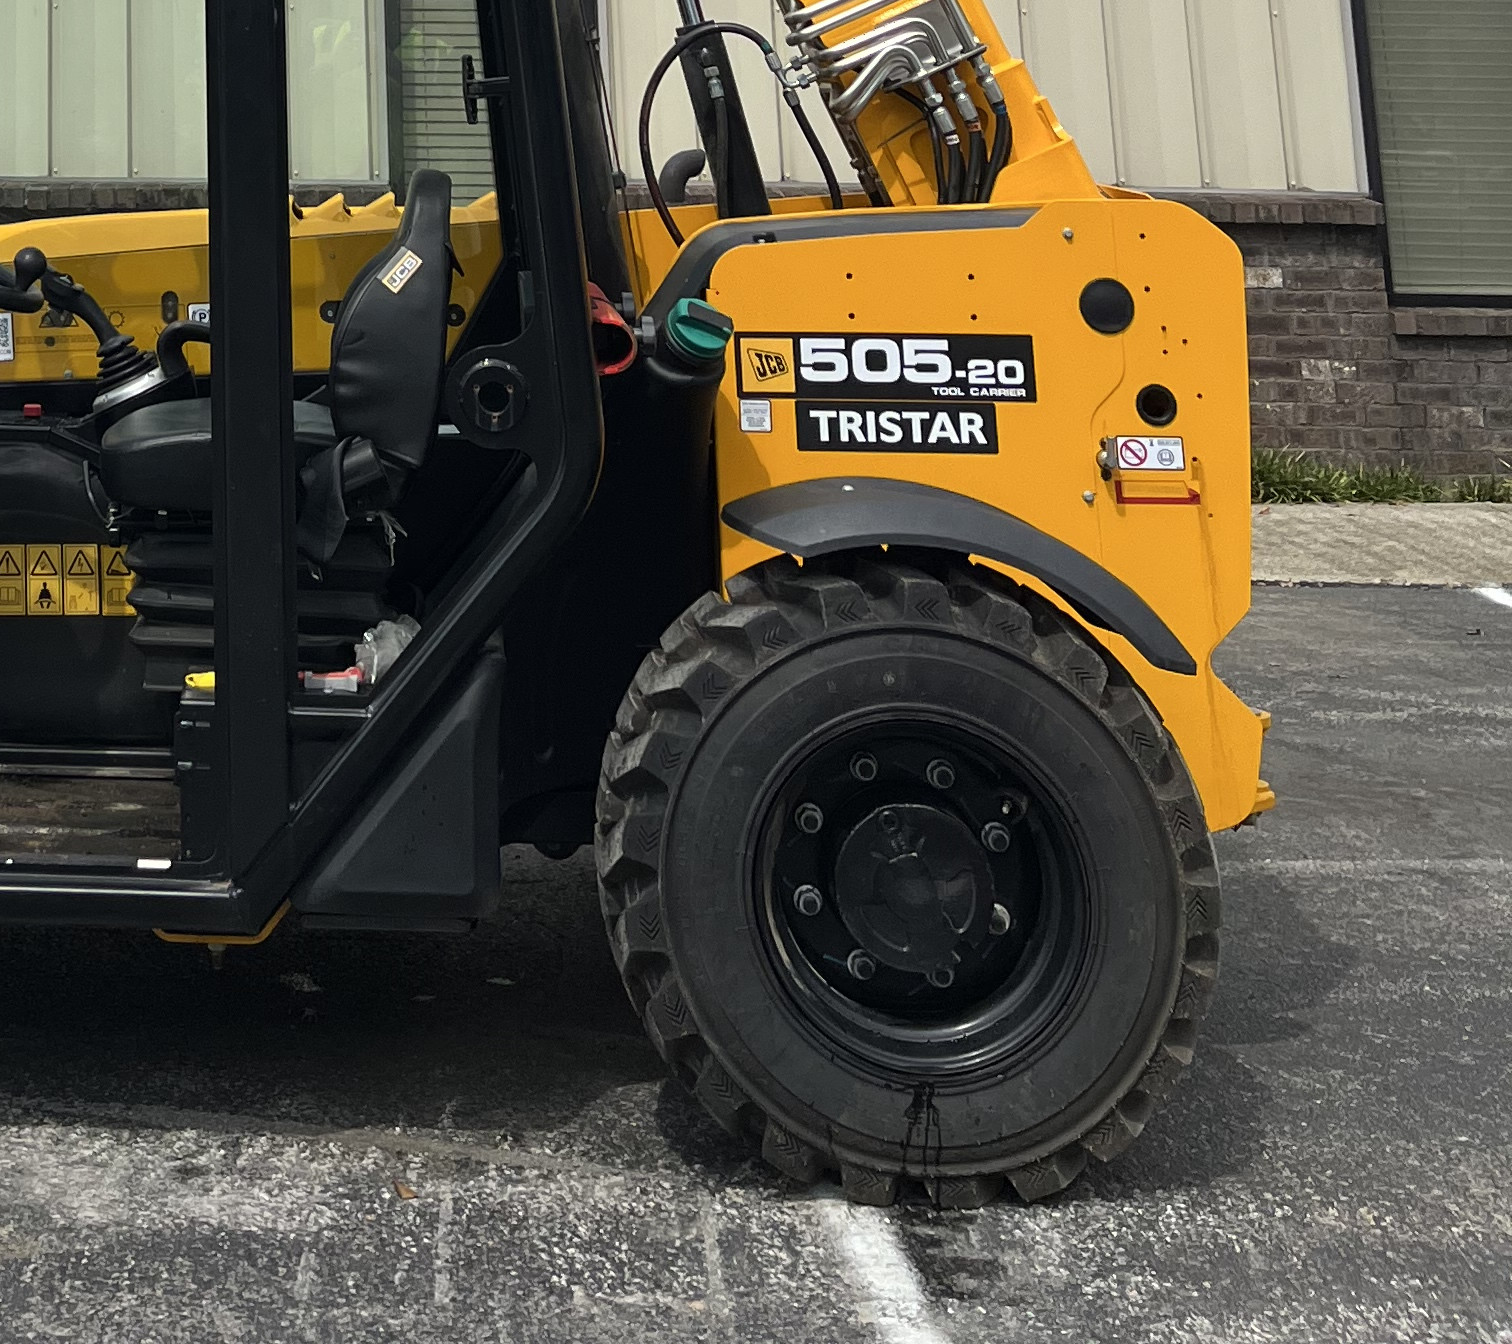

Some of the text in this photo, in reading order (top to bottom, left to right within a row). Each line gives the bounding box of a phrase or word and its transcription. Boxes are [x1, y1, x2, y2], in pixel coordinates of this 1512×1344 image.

[388, 256, 417, 287] JCB
[755, 352, 788, 379] JCB
[799, 337, 1025, 385] 505-20
[931, 386, 1027, 398] TOOL CARRIER
[809, 410, 988, 444] TRISTAR
